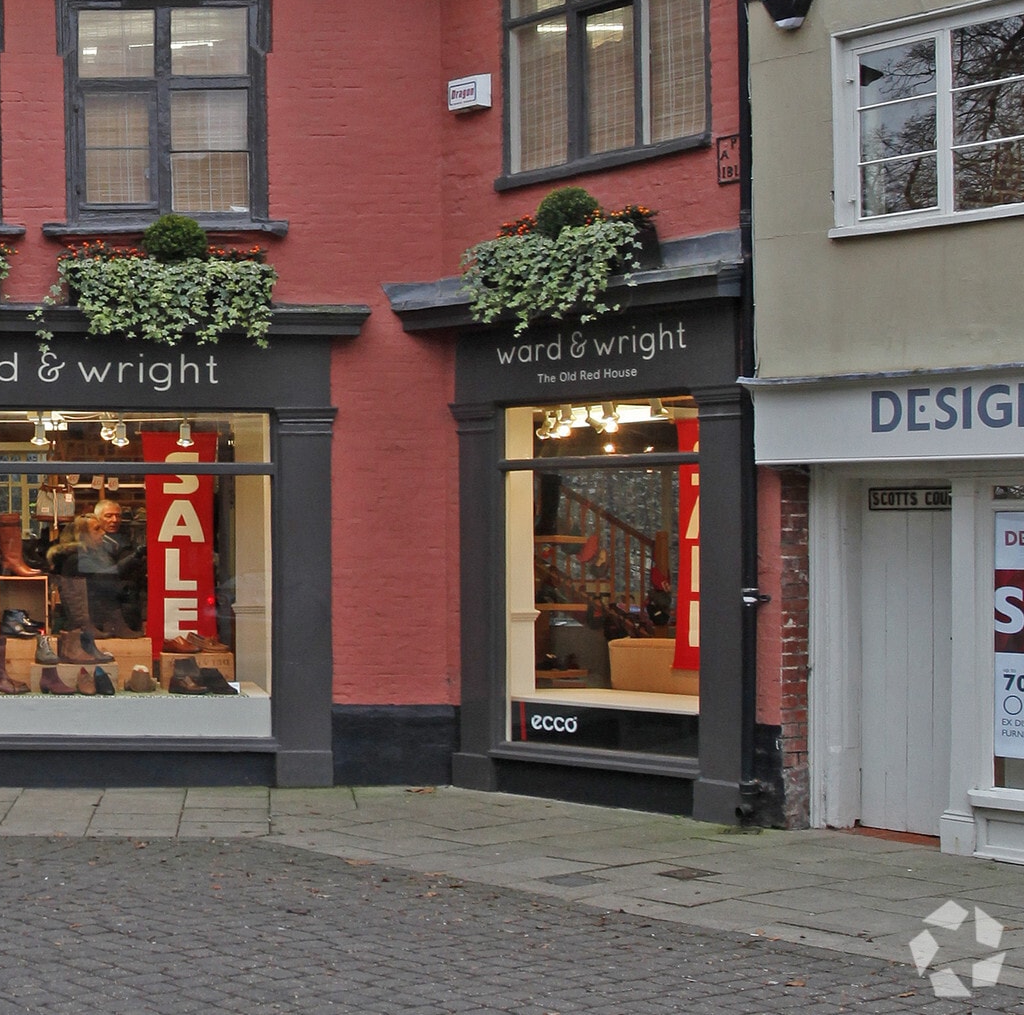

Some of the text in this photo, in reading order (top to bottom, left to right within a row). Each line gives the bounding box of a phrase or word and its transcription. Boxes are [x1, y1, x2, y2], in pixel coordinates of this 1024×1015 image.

[451, 87, 475, 100] Dragon
[496, 321, 687, 365] ward & wright
[37, 352, 66, 382] &
[77, 353, 219, 392] wright
[537, 366, 638, 384] The Old Red House
[871, 383, 1024, 433] DESIG
[872, 492, 918, 506] SCOTTS
[158, 451, 205, 639] SALE
[531, 715, 578, 733] ecco
